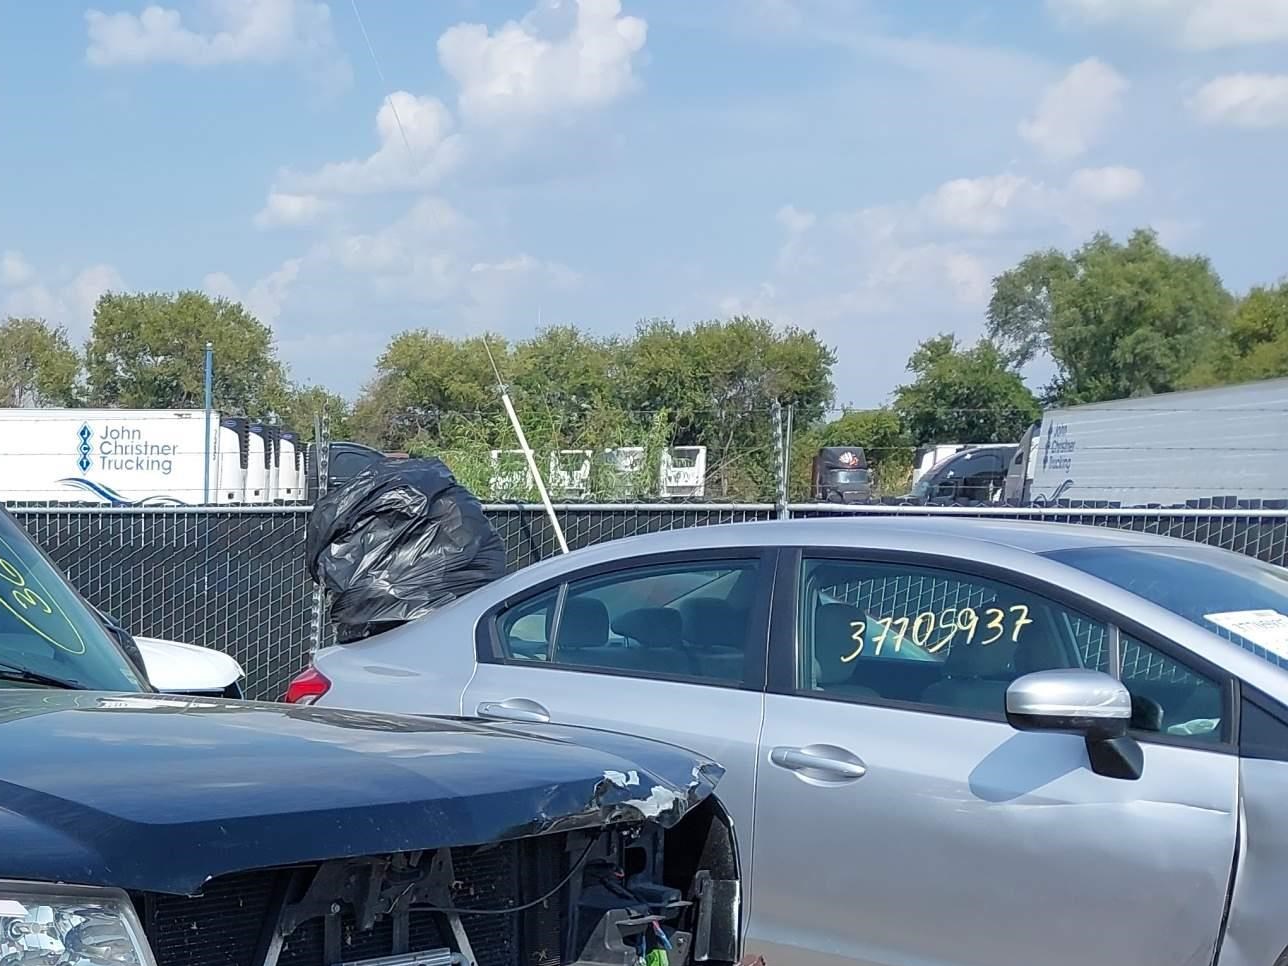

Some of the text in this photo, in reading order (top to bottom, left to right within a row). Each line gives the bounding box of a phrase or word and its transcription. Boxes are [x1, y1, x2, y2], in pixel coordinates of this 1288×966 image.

[99, 425, 142, 440] John
[99, 440, 179, 456] Christner
[99, 455, 173, 475] Trucking
[840, 604, 1033, 663] 37705937
